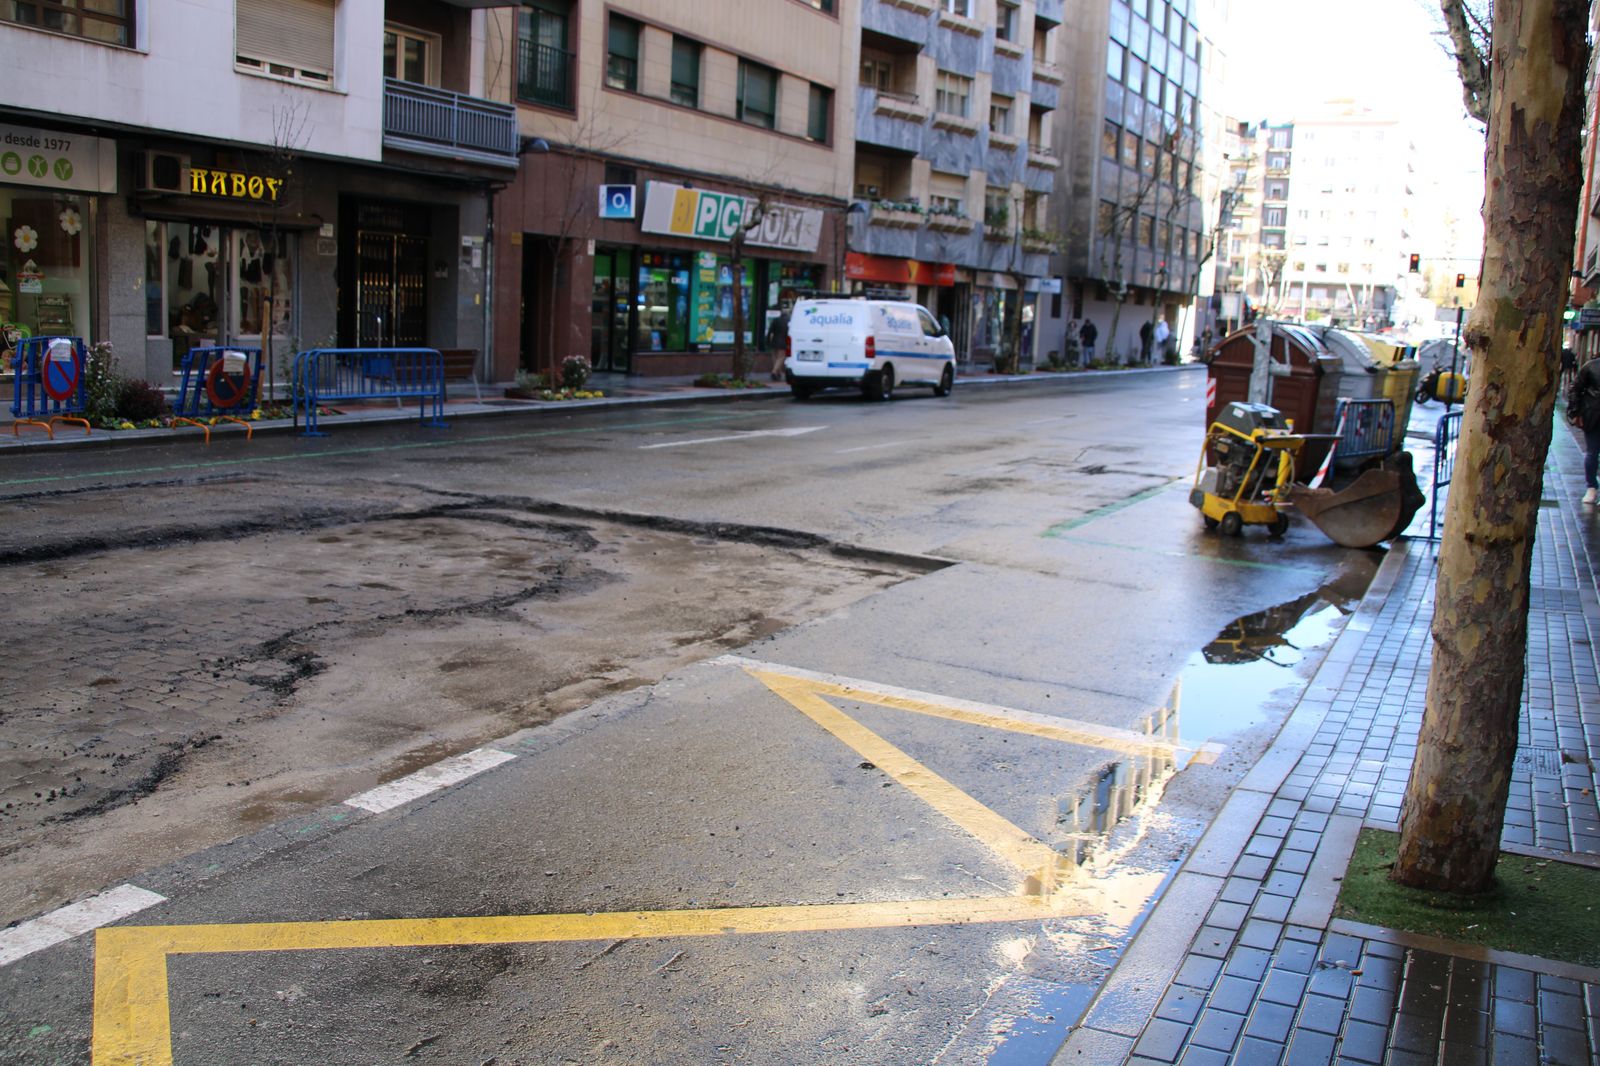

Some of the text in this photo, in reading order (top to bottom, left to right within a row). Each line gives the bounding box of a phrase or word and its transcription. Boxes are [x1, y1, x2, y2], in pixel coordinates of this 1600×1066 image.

[5, 132, 72, 152] desde 1977
[809, 312, 853, 327] aqualia
